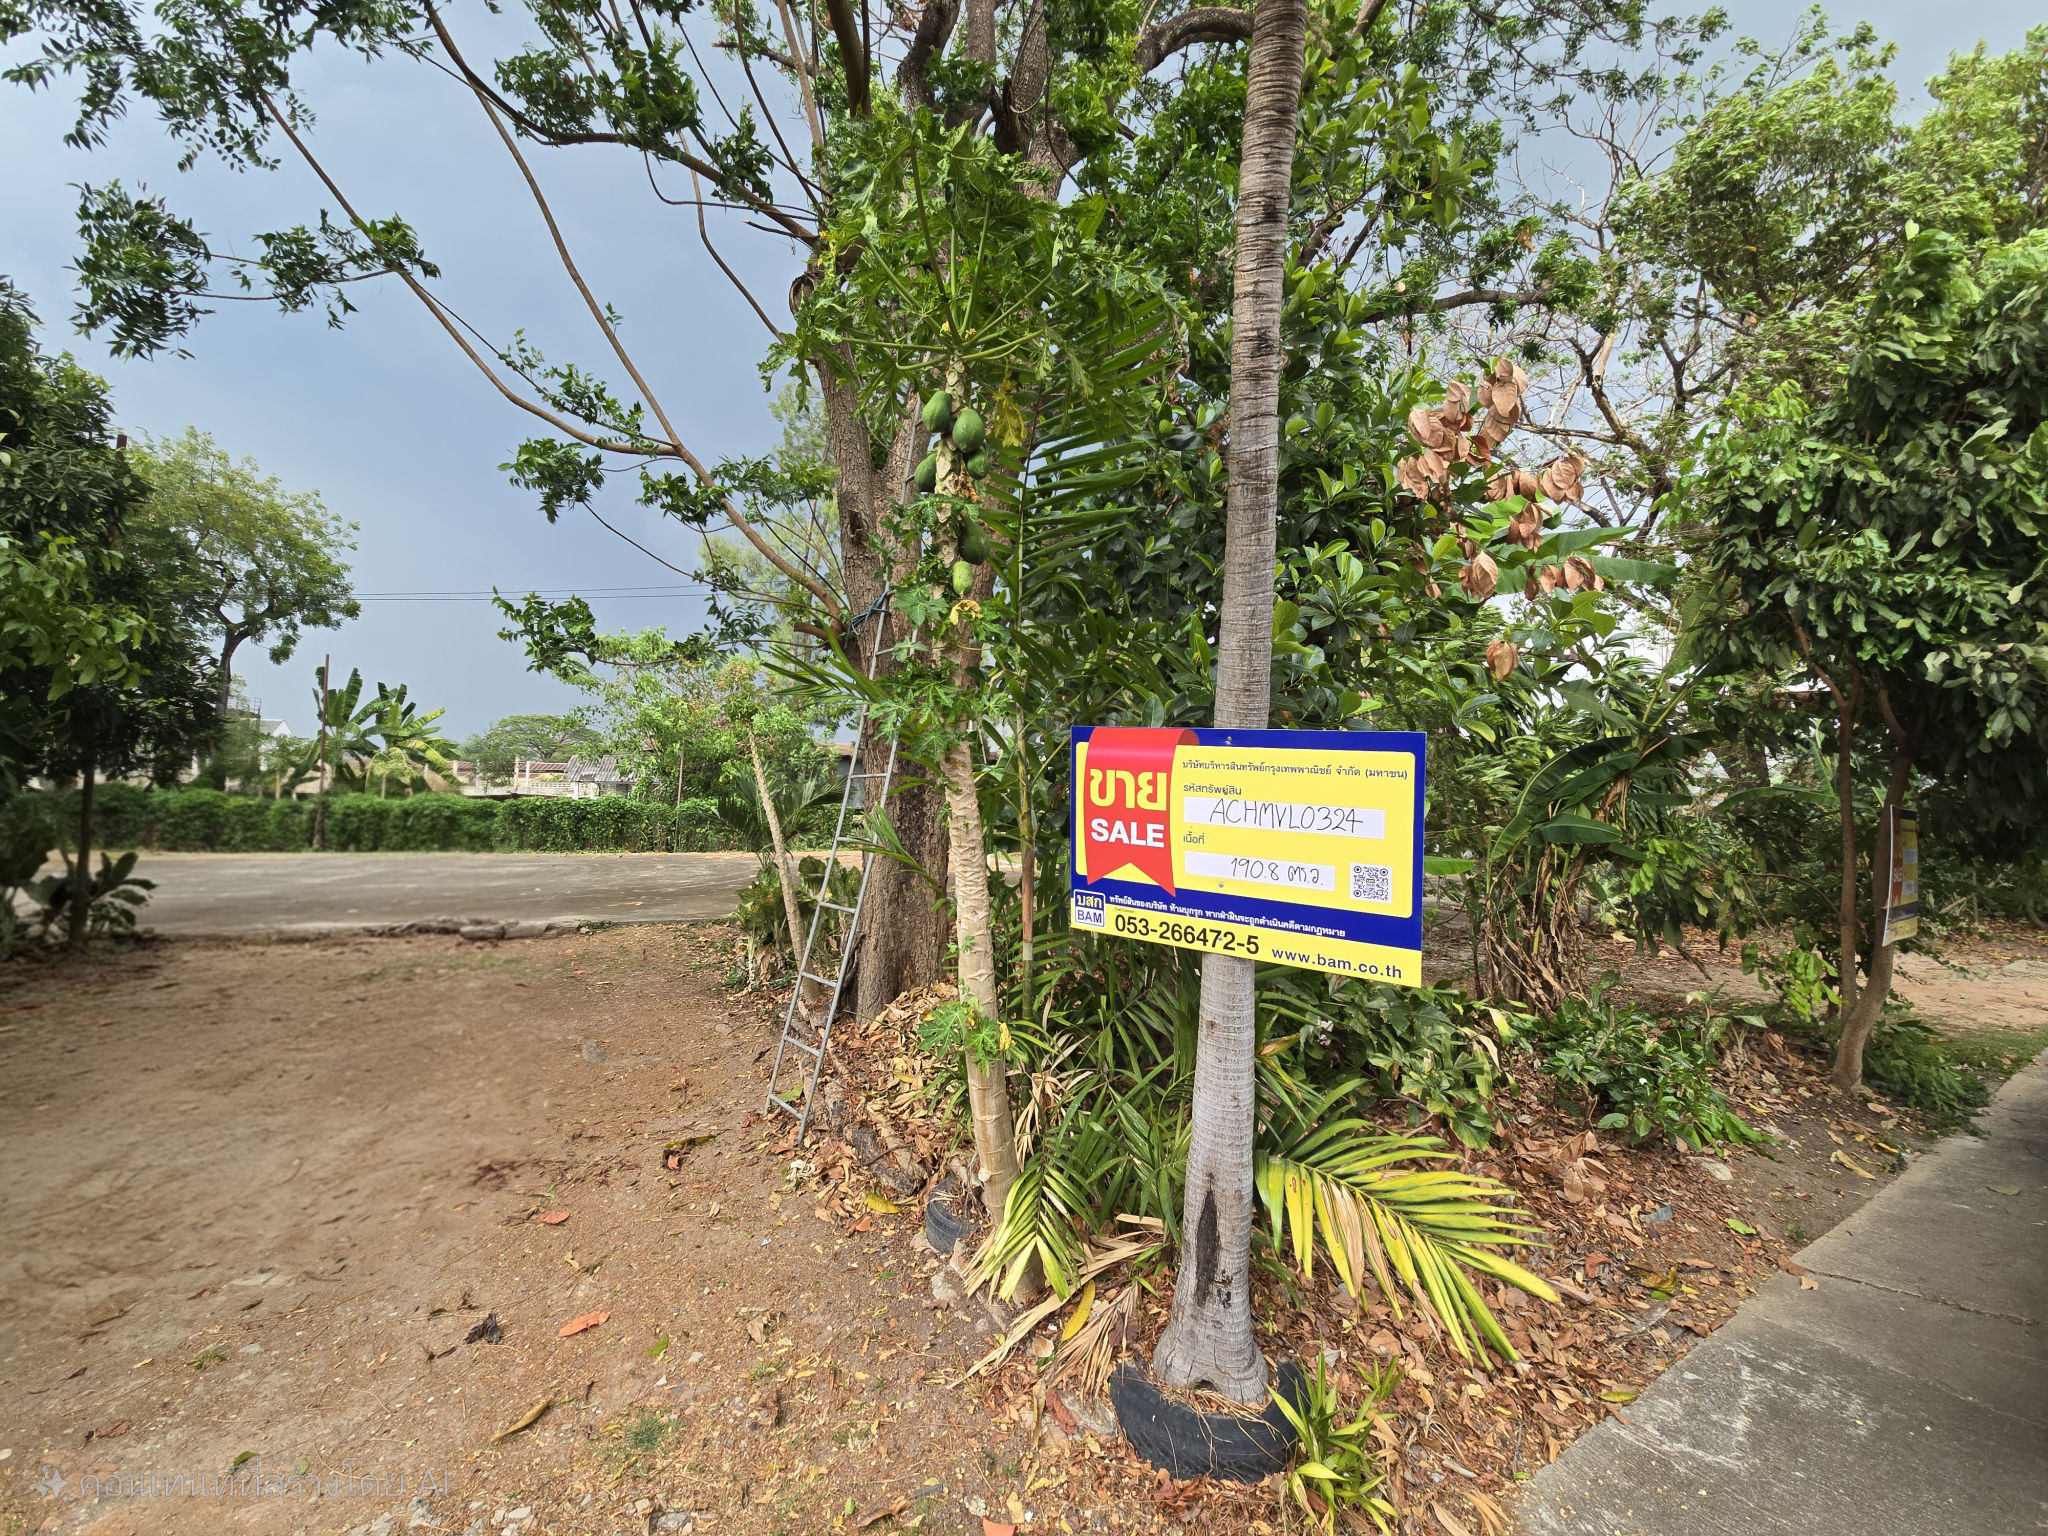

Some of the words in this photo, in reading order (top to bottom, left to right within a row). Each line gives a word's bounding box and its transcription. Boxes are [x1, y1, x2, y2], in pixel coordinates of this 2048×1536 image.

[1182, 760, 1332, 776] บริษัทบริหารสินทรัพย์กรุงเทพพาณิชย์
[1336, 766, 1361, 777] จำกัด
[1365, 768, 1408, 780] (มหาชน)
[1089, 769, 1167, 811] ขาย
[1183, 783, 1242, 796] รหัสทรัพย์สิน
[1091, 818, 1165, 848] SALE
[1183, 830, 1205, 845] เนื้อที่
[1230, 857, 1280, 881] 190.8
[1076, 894, 1102, 909] บสก
[1109, 894, 1168, 911] ทรัพย์สินของบริษัท
[1169, 903, 1204, 918] ห้ามบุกรุก
[1077, 909, 1102, 924] BAM
[1115, 914, 1260, 955] 053-266472-5
[1271, 947, 1403, 979] www.bam.co.th
